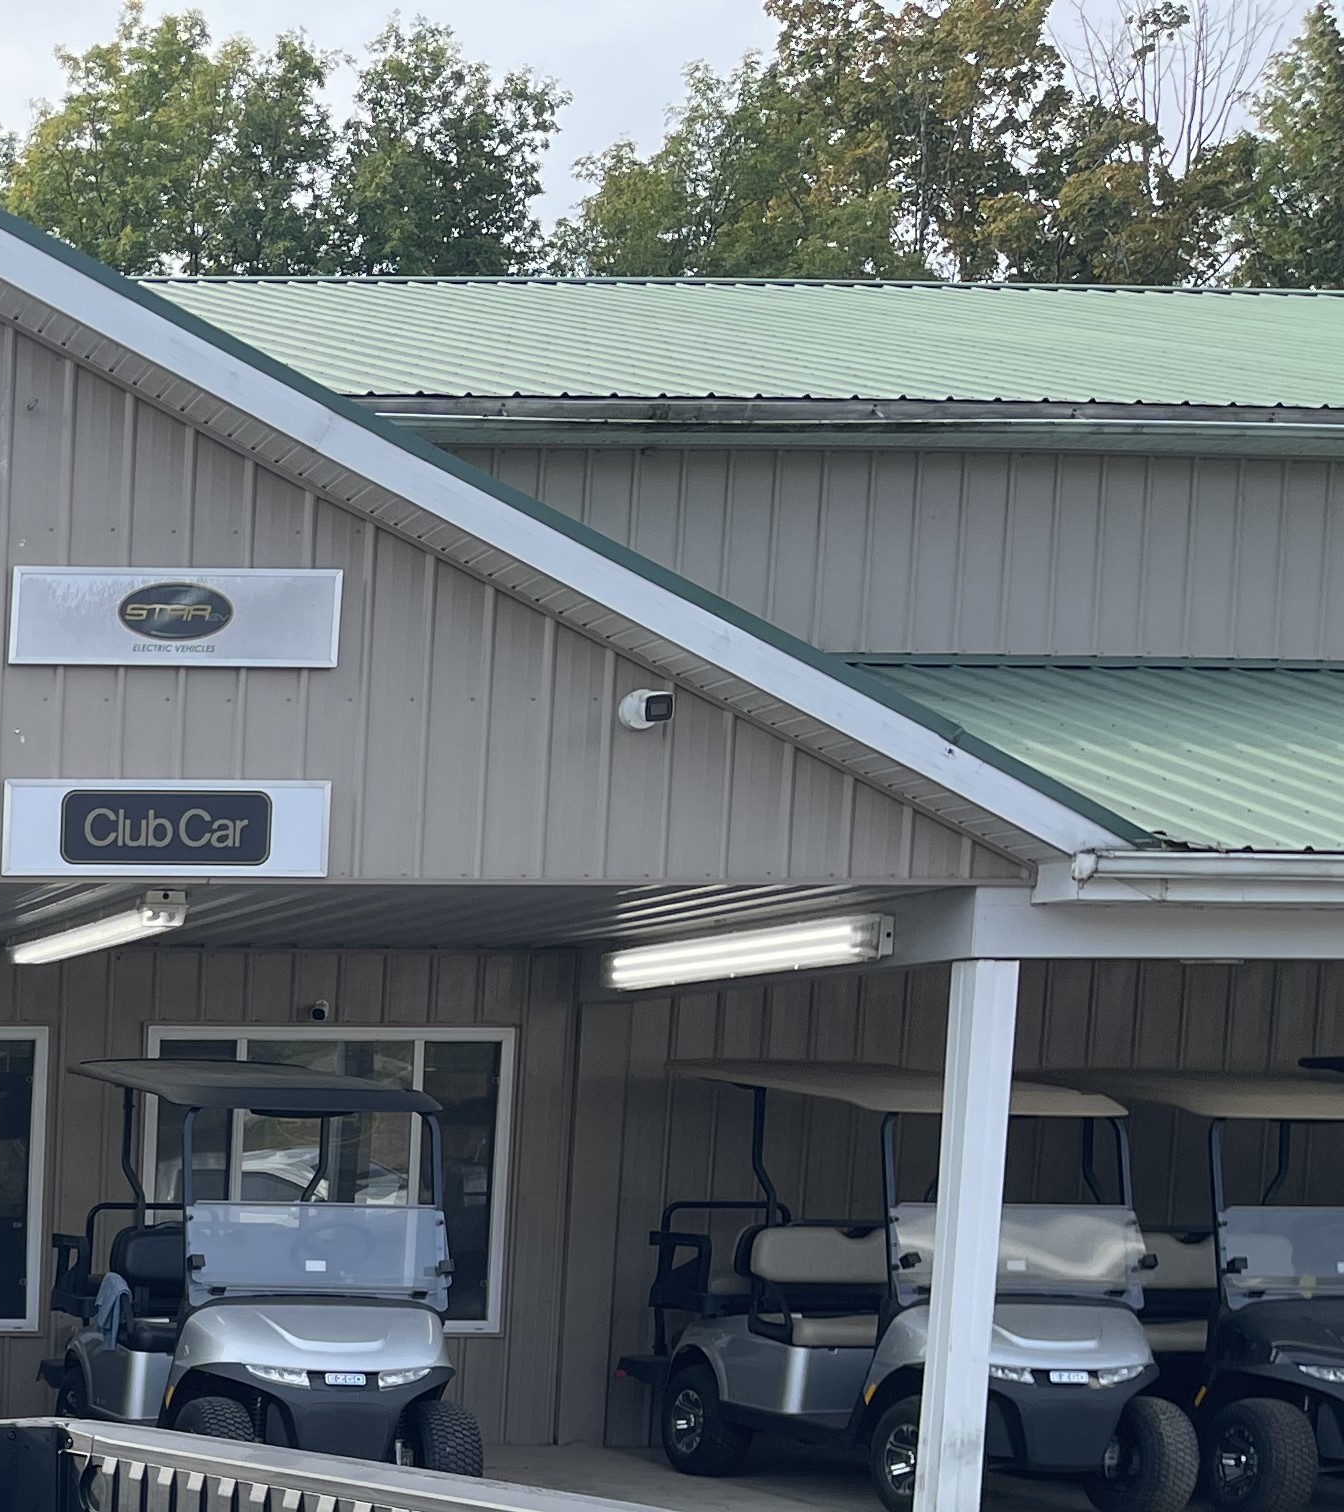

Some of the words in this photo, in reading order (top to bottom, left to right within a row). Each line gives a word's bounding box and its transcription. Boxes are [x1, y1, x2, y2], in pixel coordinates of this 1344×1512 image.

[125, 603, 212, 622] STAR
[132, 643, 173, 653] ELECTRIC
[175, 644, 216, 654] VEHICLES
[83, 807, 174, 847] Club
[178, 807, 250, 848] Car
